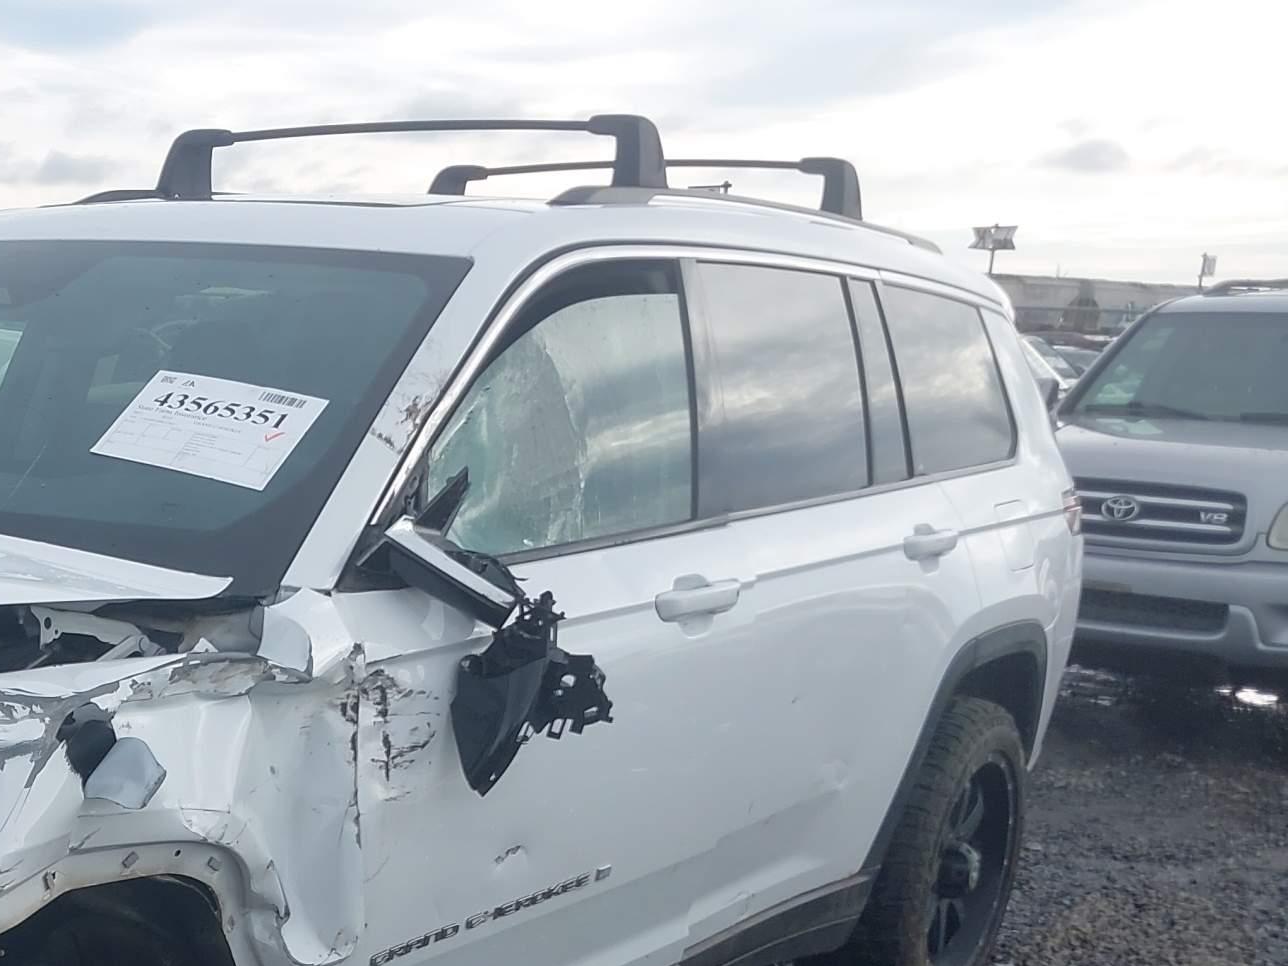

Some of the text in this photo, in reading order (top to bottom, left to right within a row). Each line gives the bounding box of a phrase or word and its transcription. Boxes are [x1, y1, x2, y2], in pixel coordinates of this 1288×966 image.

[153, 391, 288, 429] 43565351
[1199, 511, 1229, 524] V8
[465, 872, 591, 930] CHEROKEE
